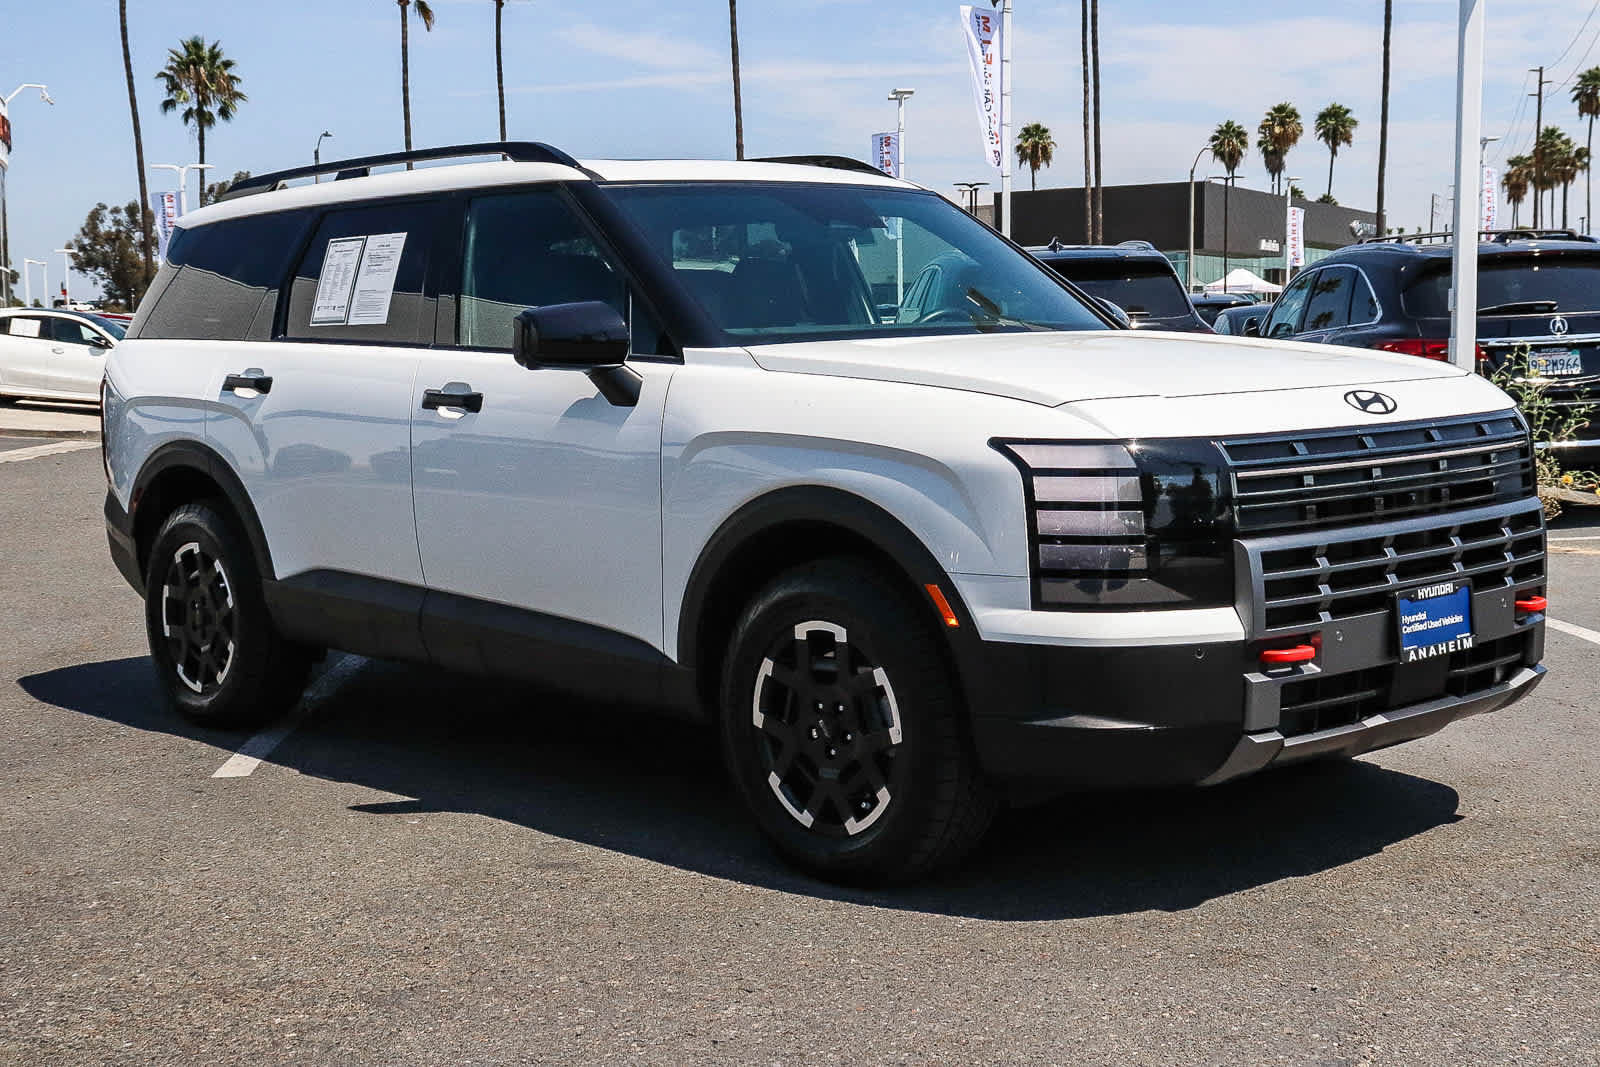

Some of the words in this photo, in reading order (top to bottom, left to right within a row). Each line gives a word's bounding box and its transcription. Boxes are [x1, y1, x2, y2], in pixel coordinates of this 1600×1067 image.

[1418, 583, 1454, 599] HYUNDAI
[1402, 611, 1427, 624] Hyundai
[1402, 621, 1428, 634] Certified
[1428, 618, 1442, 628] Used
[1442, 615, 1463, 625] Vehicles
[1408, 637, 1473, 662] ANAHEIM
